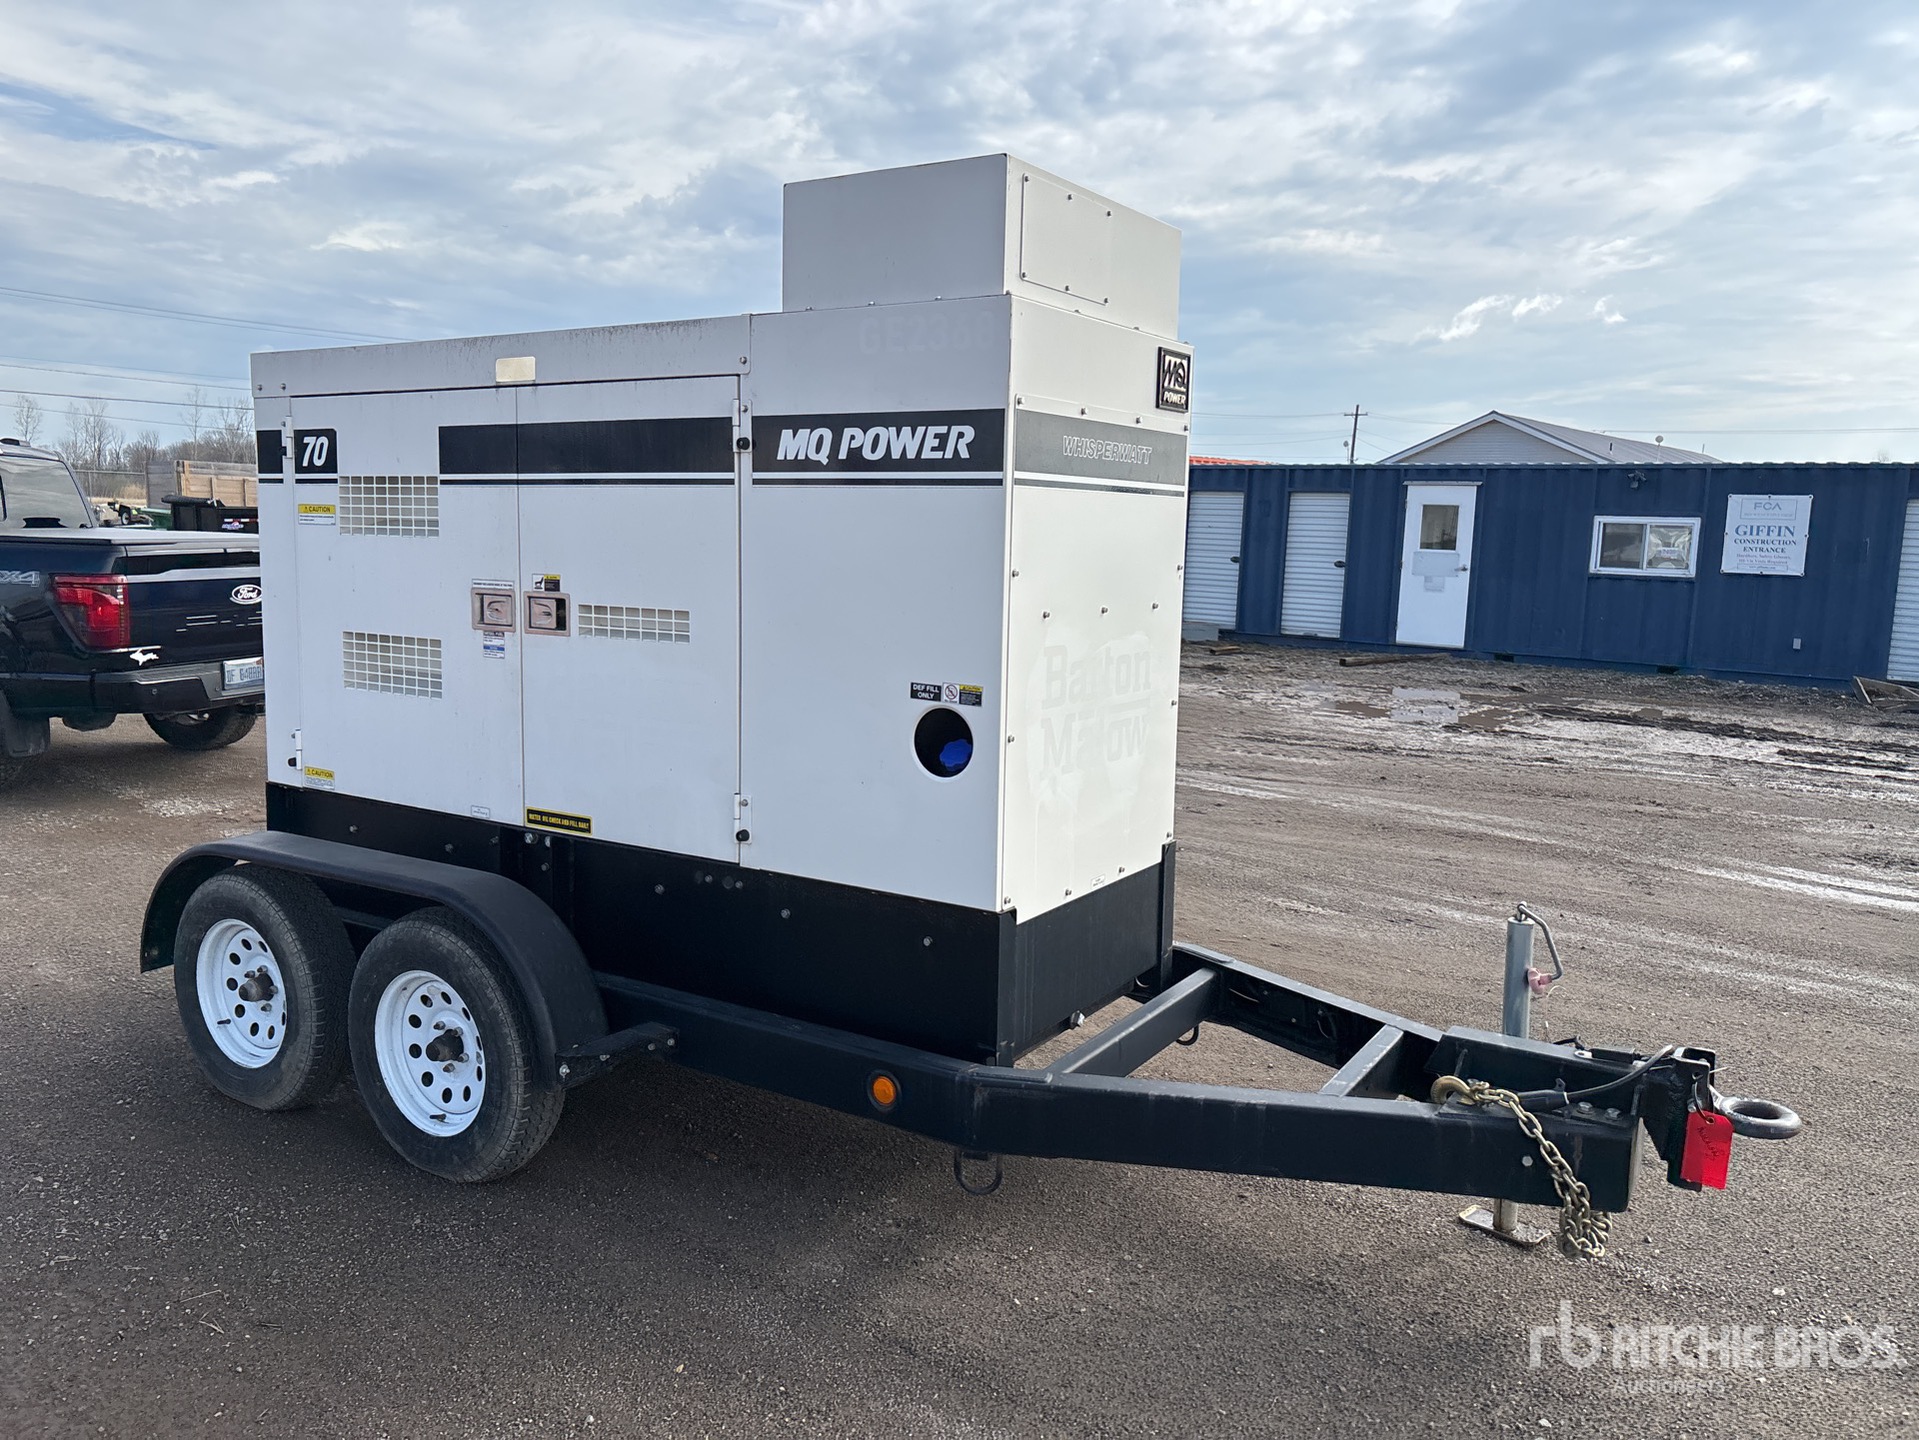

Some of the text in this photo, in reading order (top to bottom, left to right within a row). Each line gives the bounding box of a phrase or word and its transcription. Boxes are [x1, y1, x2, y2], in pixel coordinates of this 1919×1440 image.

[1162, 357, 1187, 390] MQ
[1163, 391, 1187, 405] POWER
[302, 436, 329, 467] 70
[776, 425, 975, 466] MQ POWER
[1063, 435, 1152, 465] WHISPERWATT
[308, 505, 331, 513] CAUTION
[1753, 501, 1782, 511] FCA
[1734, 524, 1796, 537] GIFFIN
[1733, 537, 1797, 546] CONSTRUCTION
[1743, 546, 1786, 554] ENTRANCE
[238, 586, 258, 599] Ford
[912, 683, 939, 693] DEF FILL
[917, 691, 934, 699] ONLY
